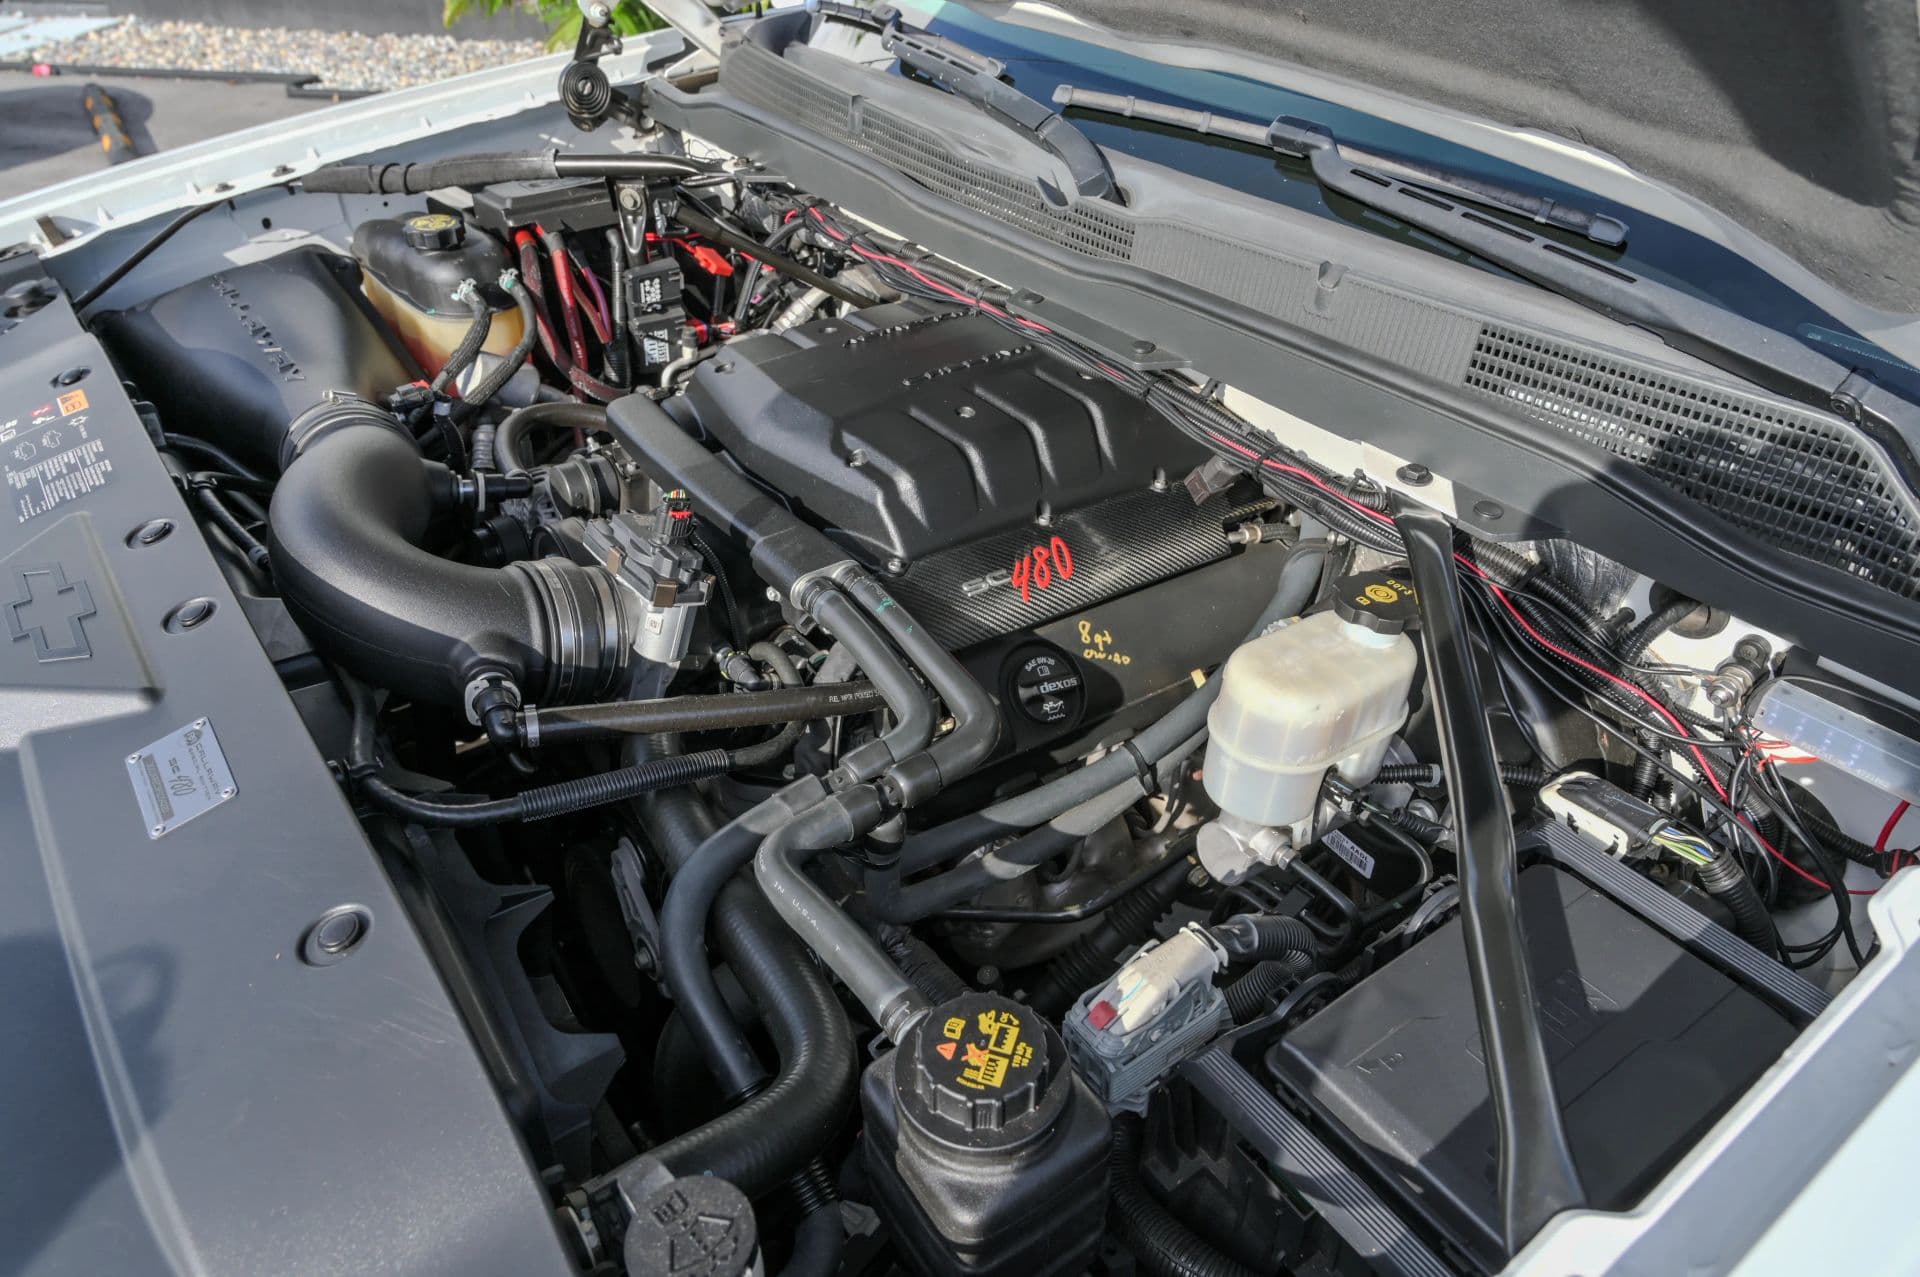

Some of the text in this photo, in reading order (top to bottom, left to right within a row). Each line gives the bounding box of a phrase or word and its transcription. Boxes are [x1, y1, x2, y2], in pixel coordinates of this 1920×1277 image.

[962, 535, 1075, 604] SC 480
[1078, 620, 1092, 644] 8
[1024, 659, 1038, 672] SAE
[1039, 677, 1079, 694] dexos
[195, 742, 222, 796] CALLAWAY
[167, 775, 197, 797] 480
